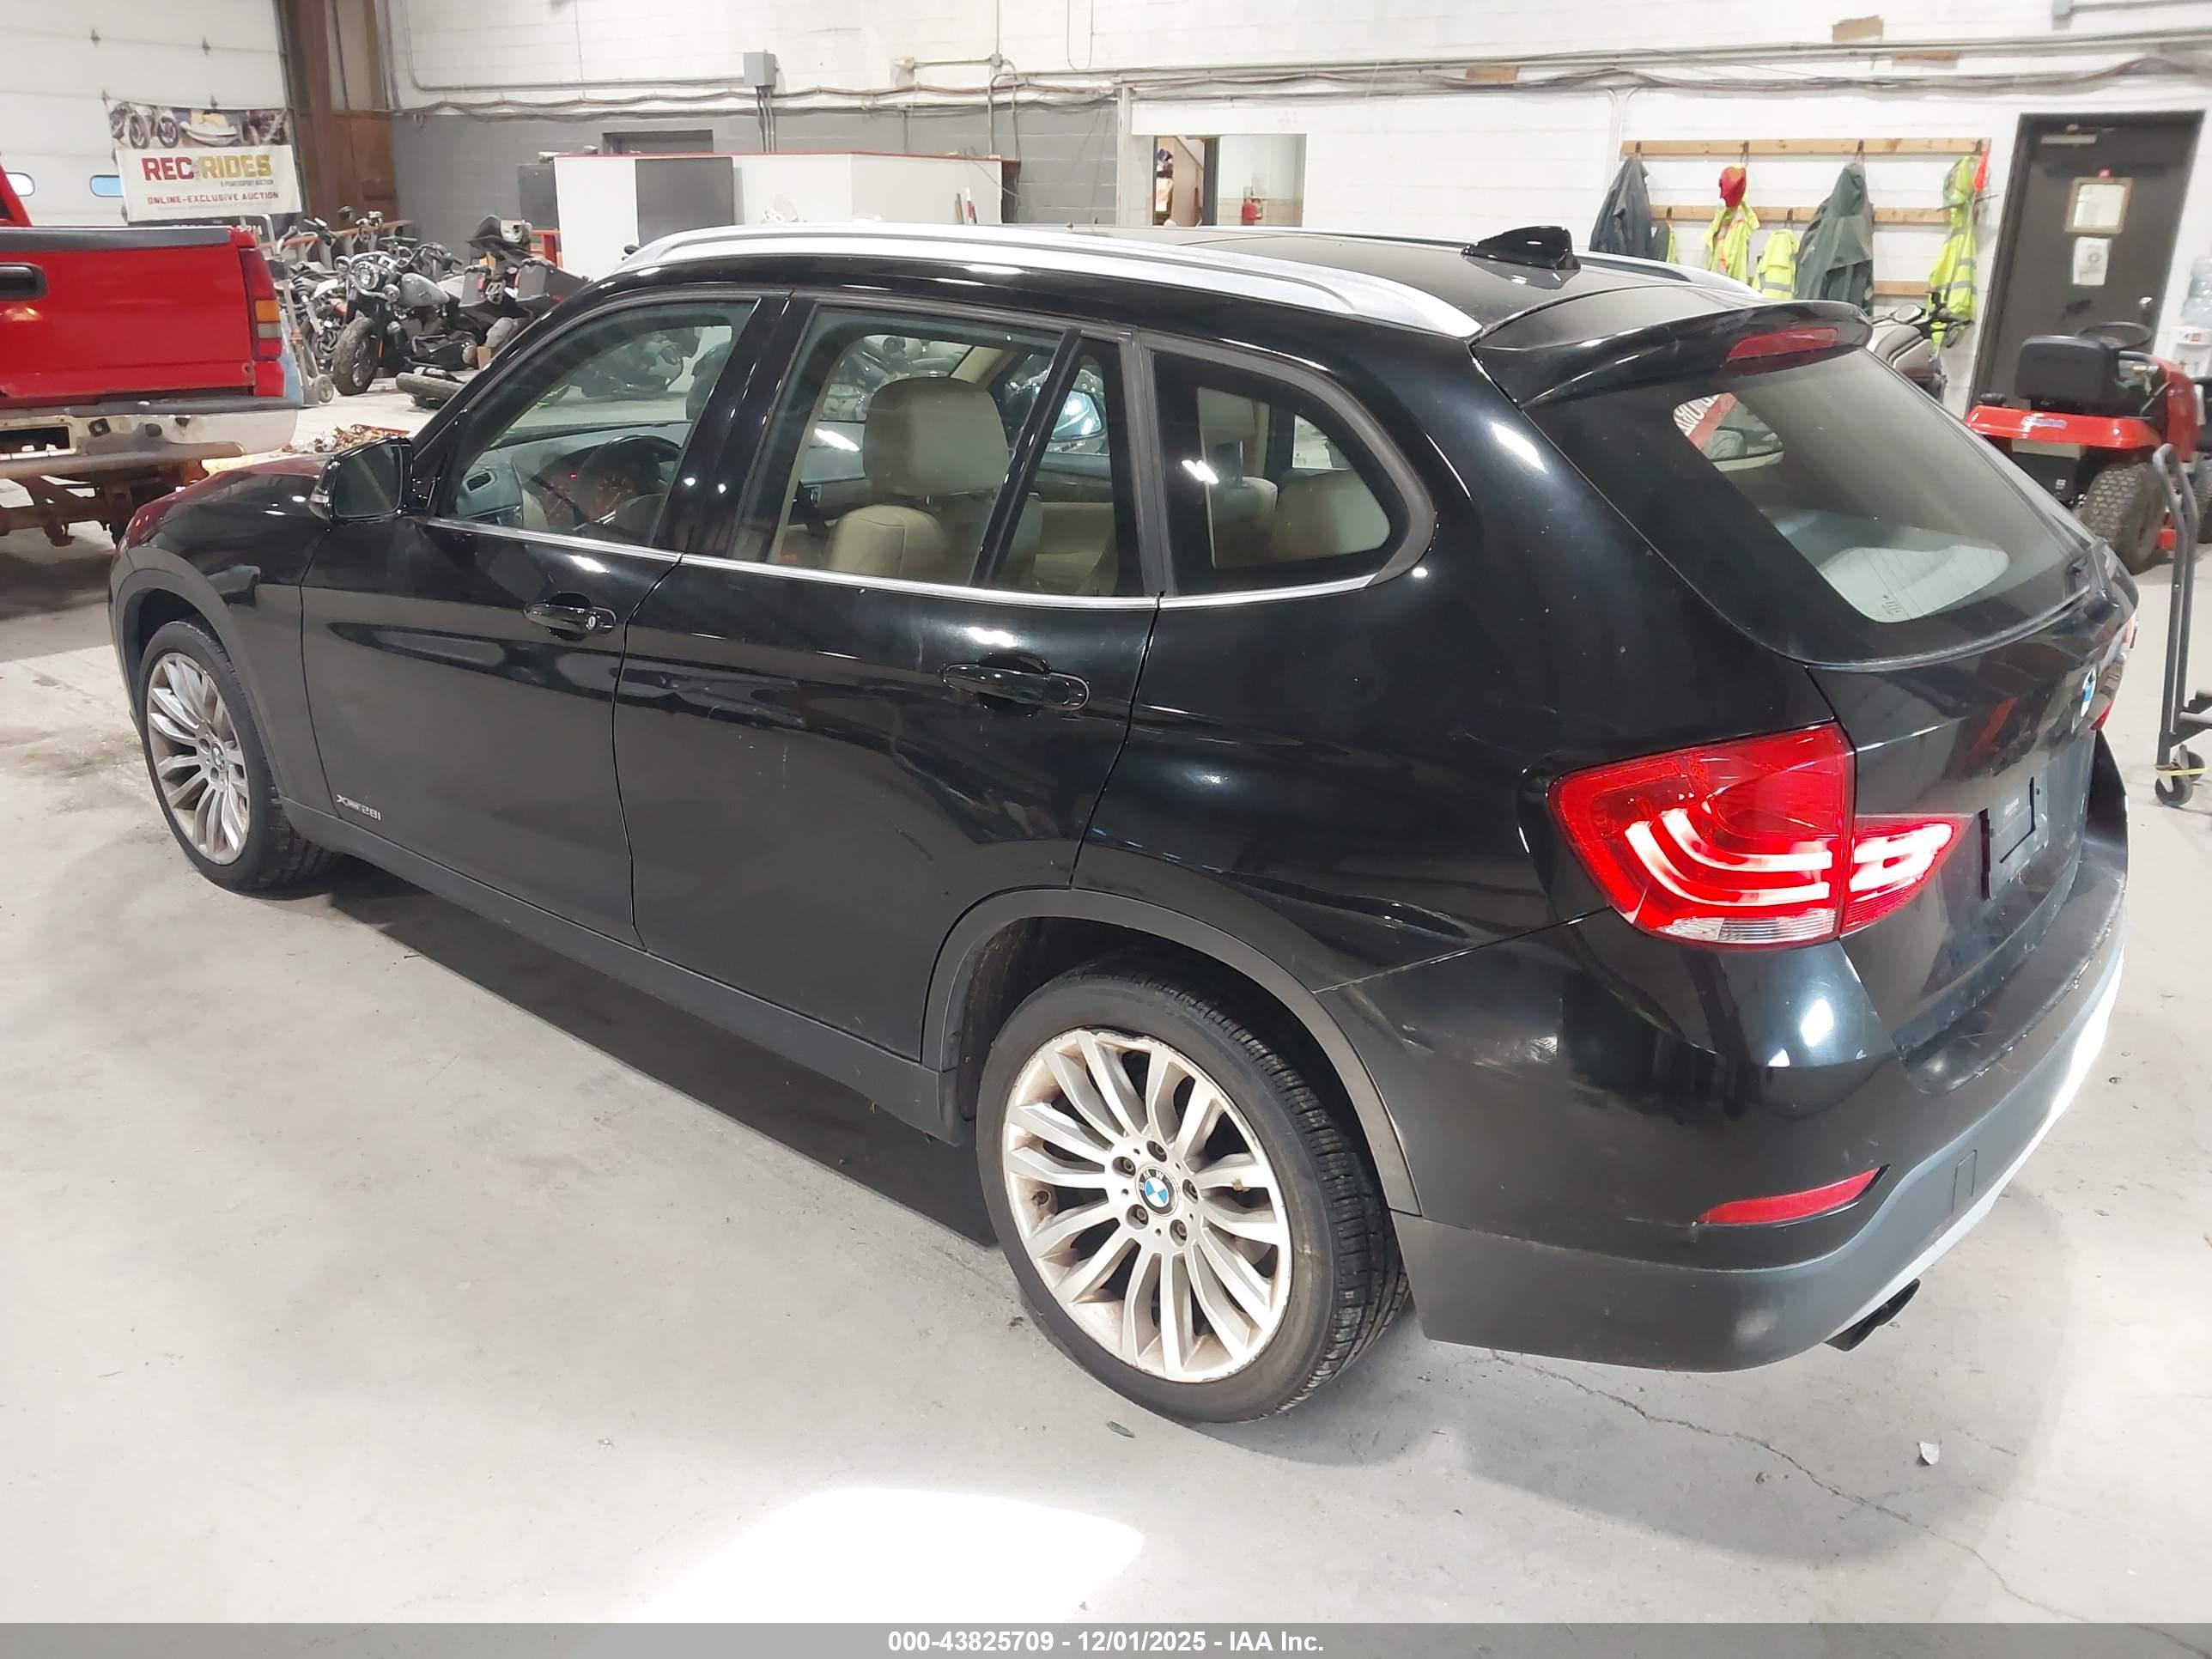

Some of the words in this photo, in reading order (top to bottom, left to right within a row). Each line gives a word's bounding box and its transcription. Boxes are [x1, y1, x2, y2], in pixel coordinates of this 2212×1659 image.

[142, 157, 195, 181] REC
[198, 155, 273, 179] RIDES
[148, 193, 239, 205] ONLINE-EXCLUSIVE
[241, 191, 279, 200] AUCTION
[1139, 1170, 1164, 1191] BMW
